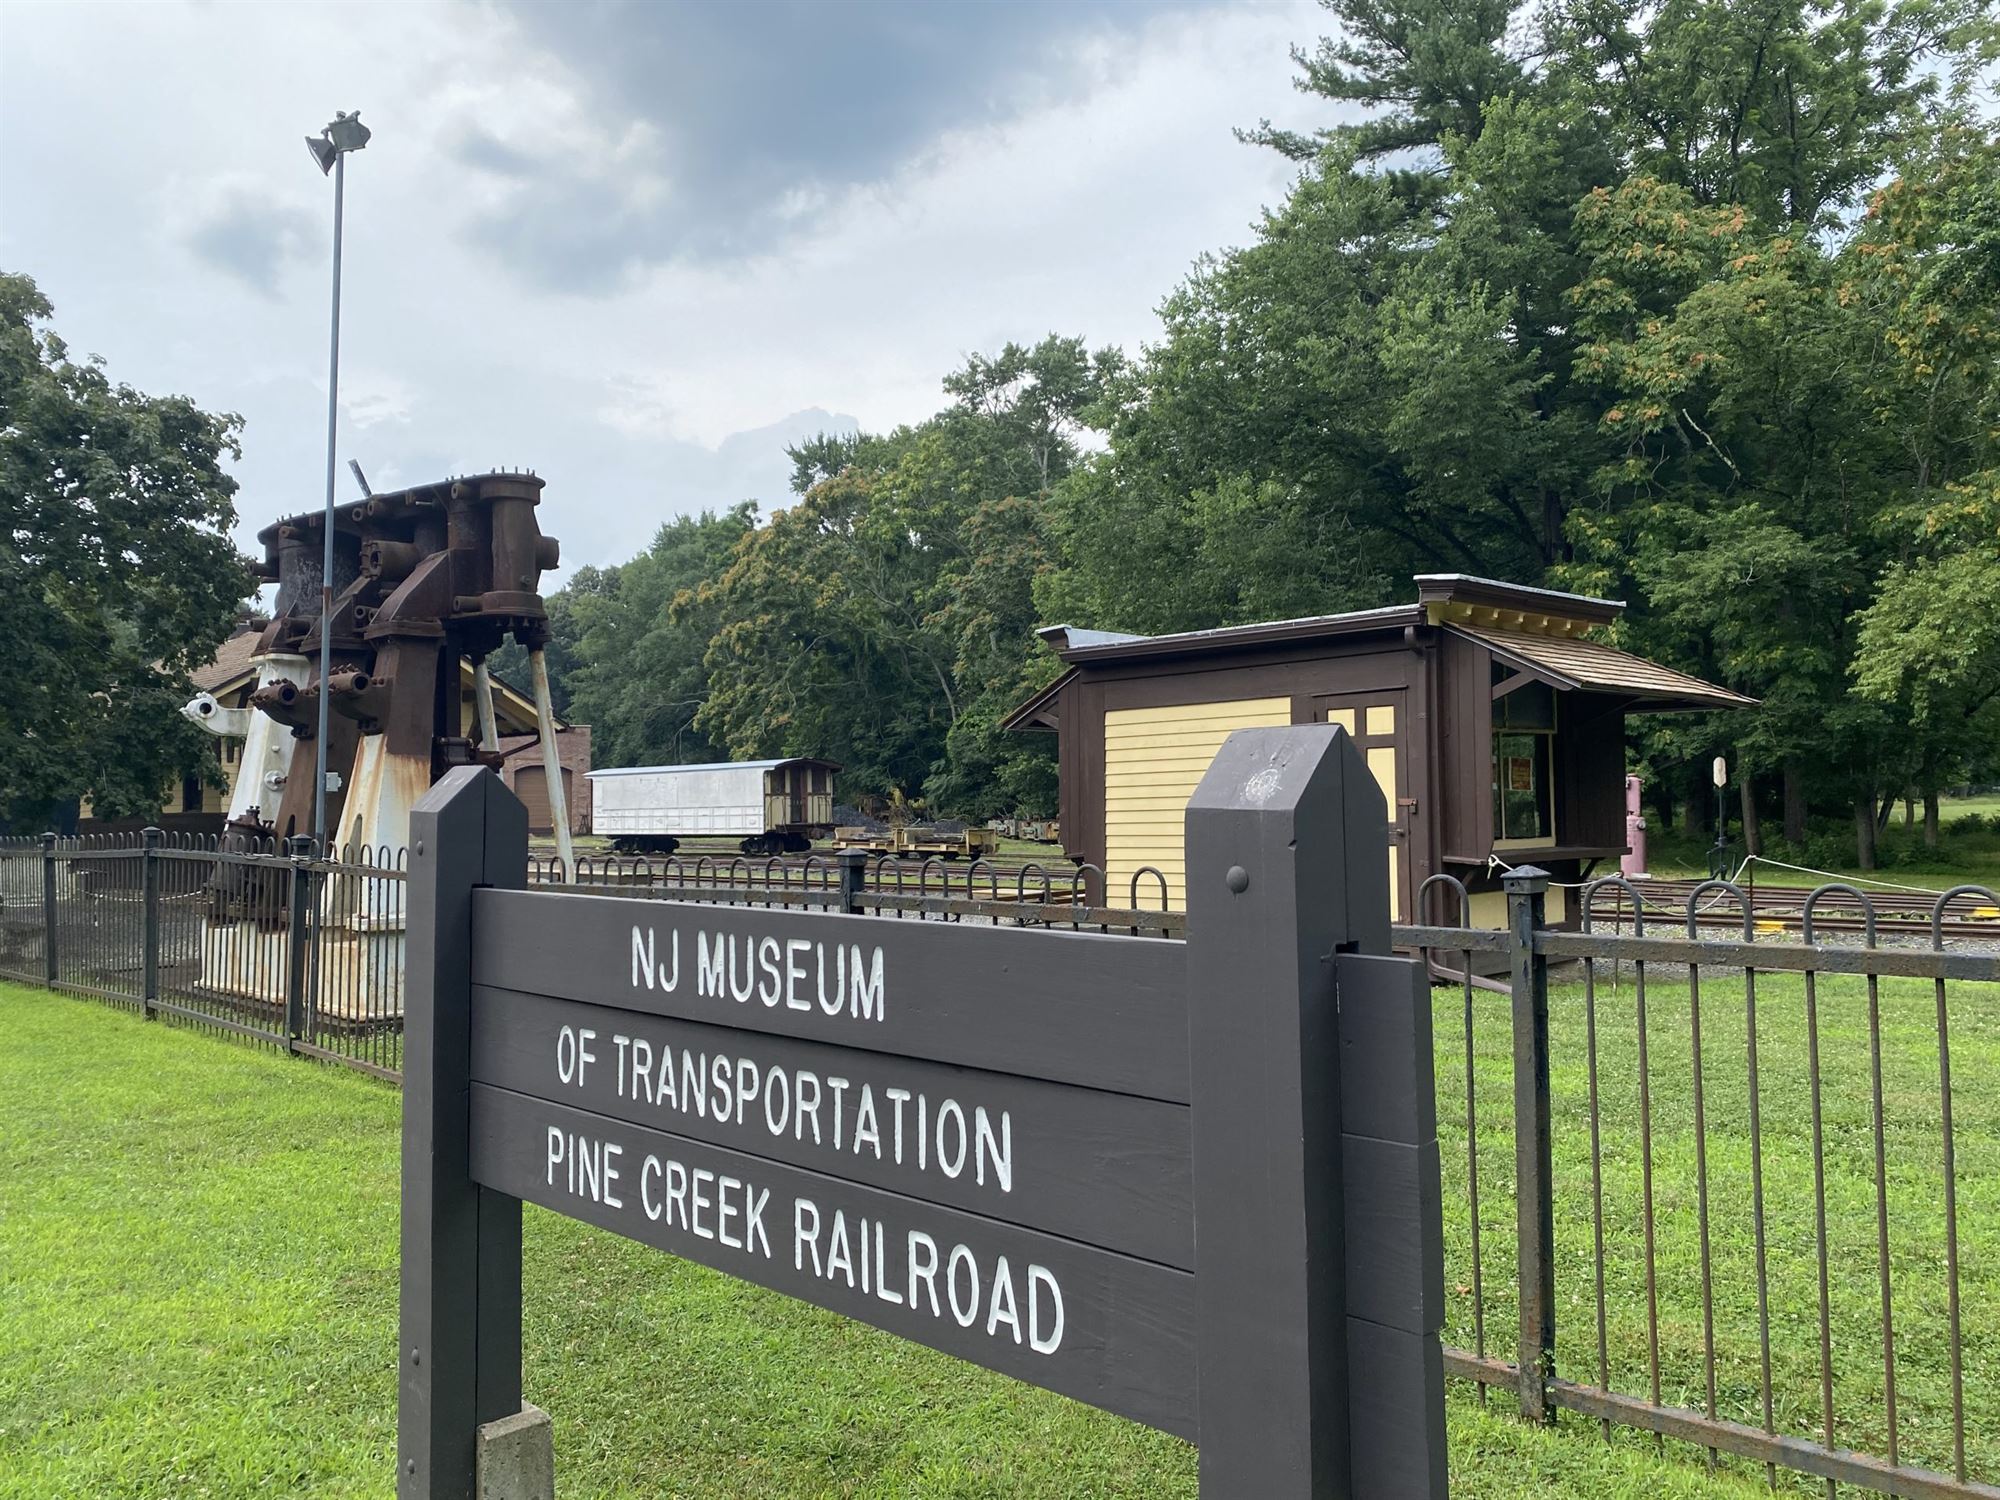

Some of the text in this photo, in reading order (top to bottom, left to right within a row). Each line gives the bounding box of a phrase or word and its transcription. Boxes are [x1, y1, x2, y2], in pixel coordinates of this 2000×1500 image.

[632, 926, 884, 1022] NJ MUSEUM
[557, 1025, 1011, 1192] OF TRANSPORTATION
[548, 1126, 1064, 1354] PINE CREEK RAILROAD
